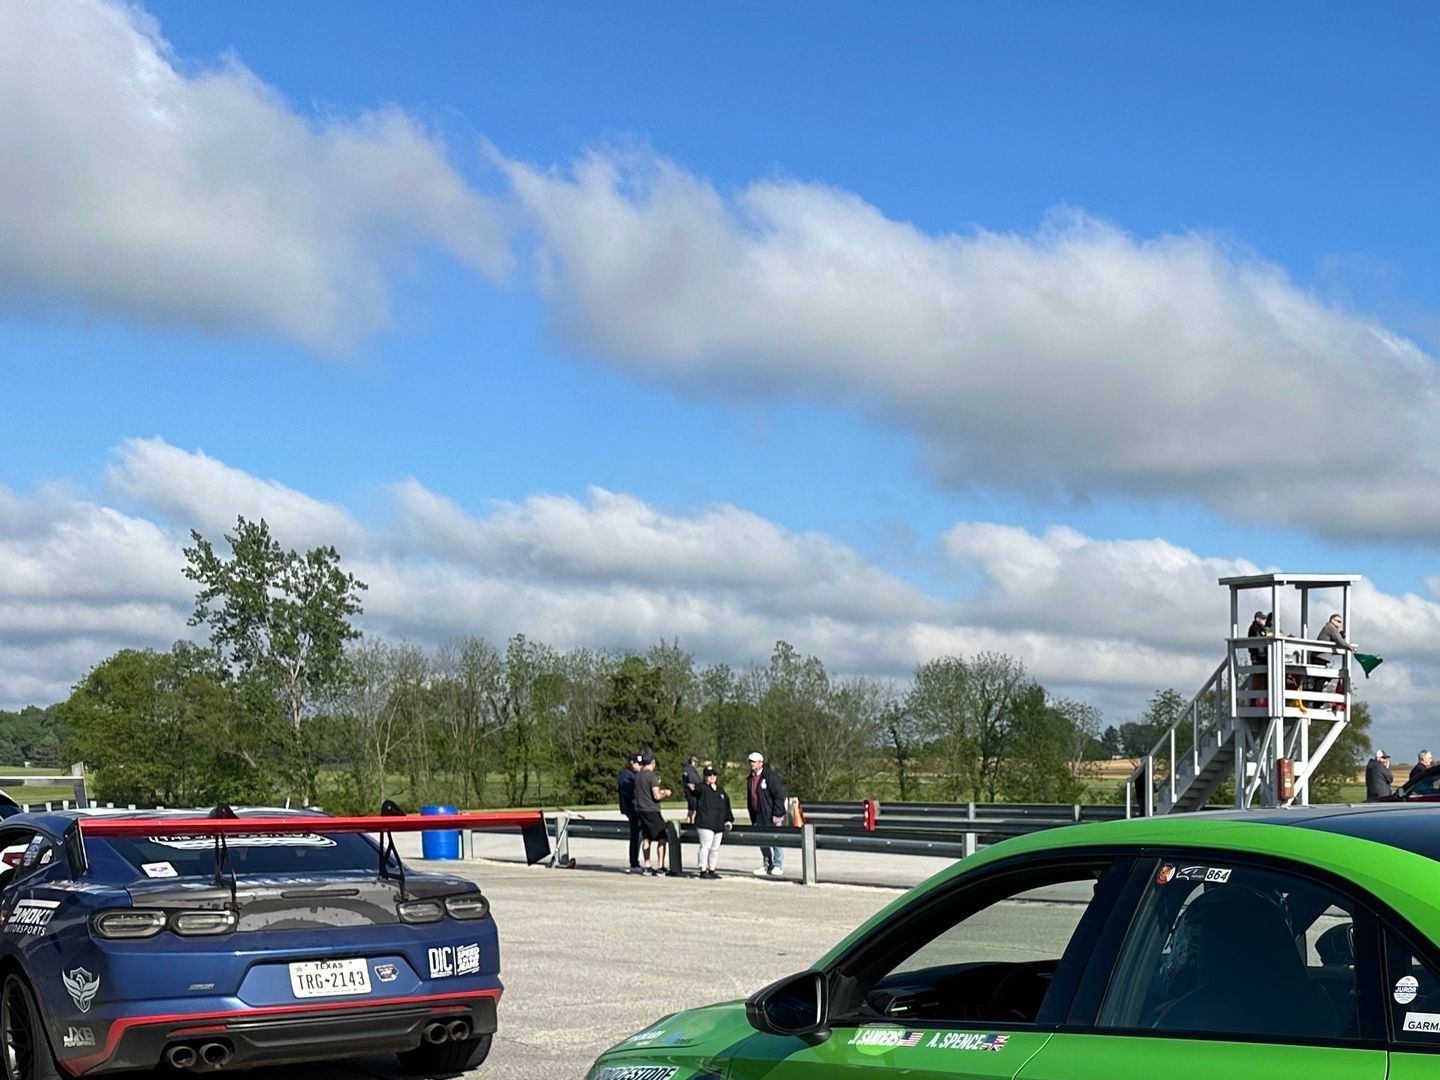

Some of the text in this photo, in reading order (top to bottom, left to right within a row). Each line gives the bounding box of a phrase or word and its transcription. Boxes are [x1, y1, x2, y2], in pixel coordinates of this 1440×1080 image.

[1207, 870, 1229, 881] 864
[314, 962, 344, 970] TEXAS
[428, 946, 453, 972] DIC
[857, 1030, 904, 1047] SANDERS
[939, 1034, 987, 1050] SPENCE
